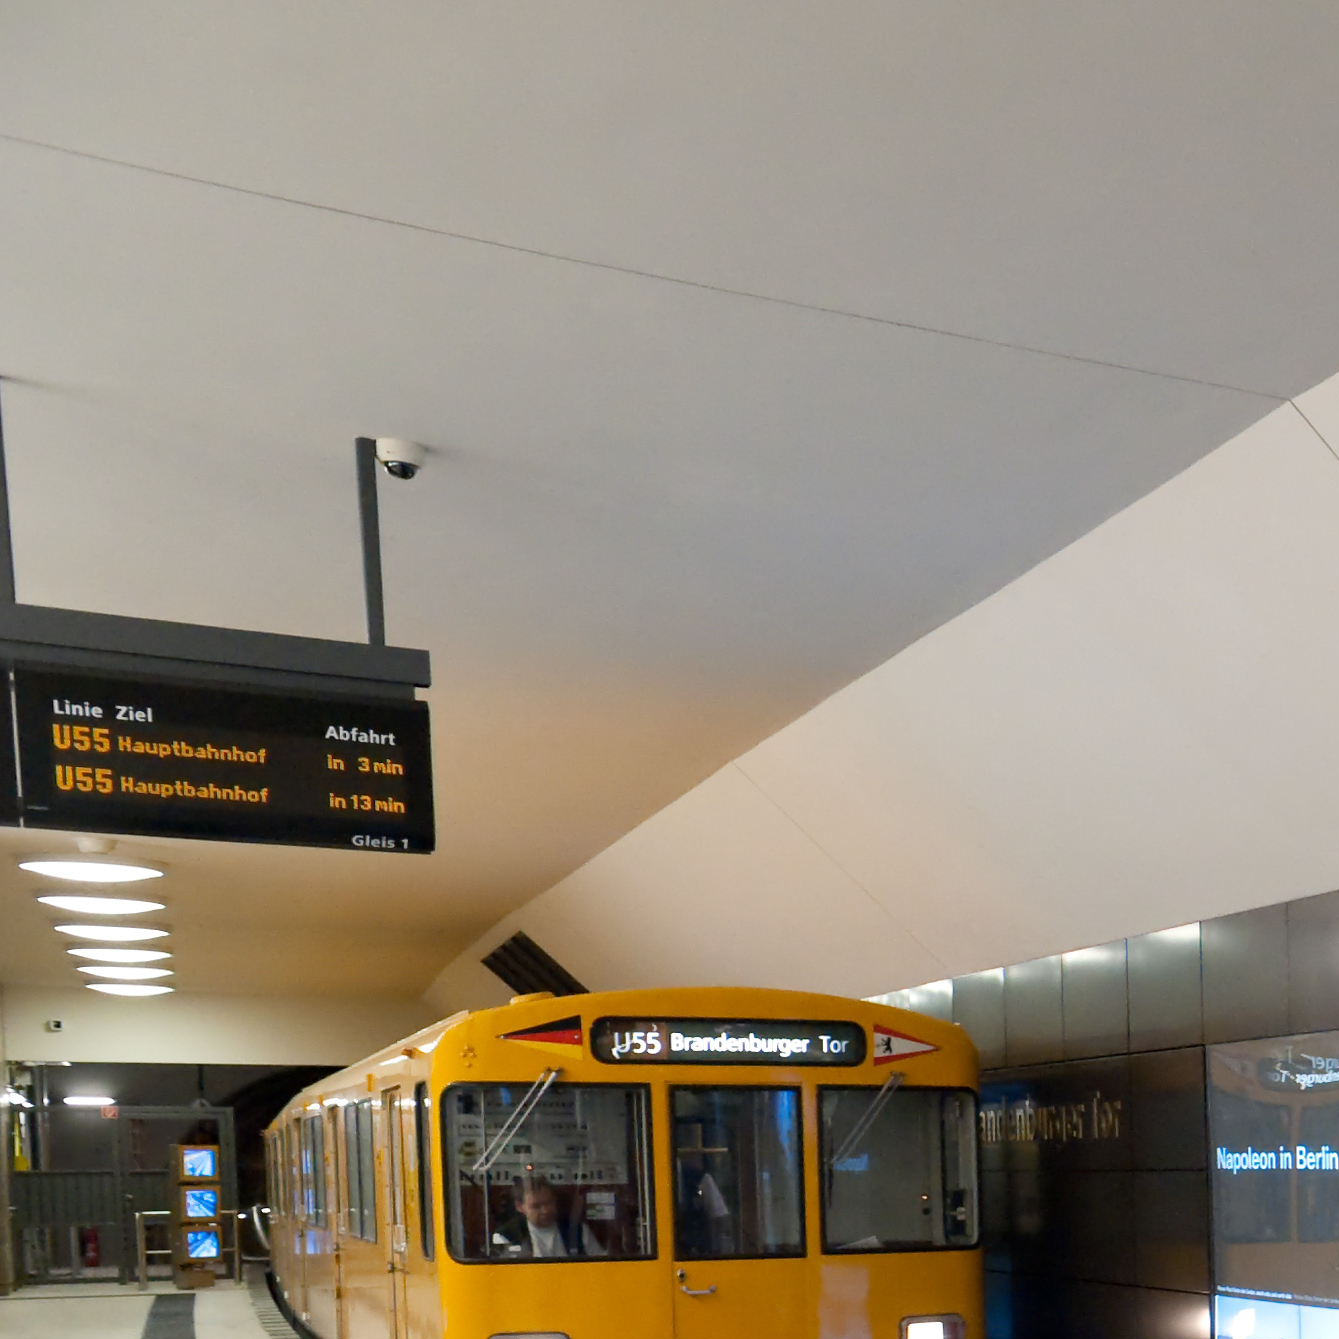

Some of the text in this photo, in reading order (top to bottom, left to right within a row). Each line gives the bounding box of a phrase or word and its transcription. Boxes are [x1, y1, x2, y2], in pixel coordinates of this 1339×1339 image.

[52, 699, 153, 722] Linie Ziel
[52, 723, 267, 764] U55 Hauptbahnhof
[325, 725, 396, 746] Abfahrt
[327, 753, 404, 775] in 3 min
[55, 764, 269, 803] U55 Hauptbahnhof
[329, 792, 406, 813] in 13 min
[351, 834, 408, 849] Gleis 1
[613, 1031, 849, 1057] U55 Brandenburger Tor
[1216, 1145, 1339, 1175] Napoleon in Berlin
